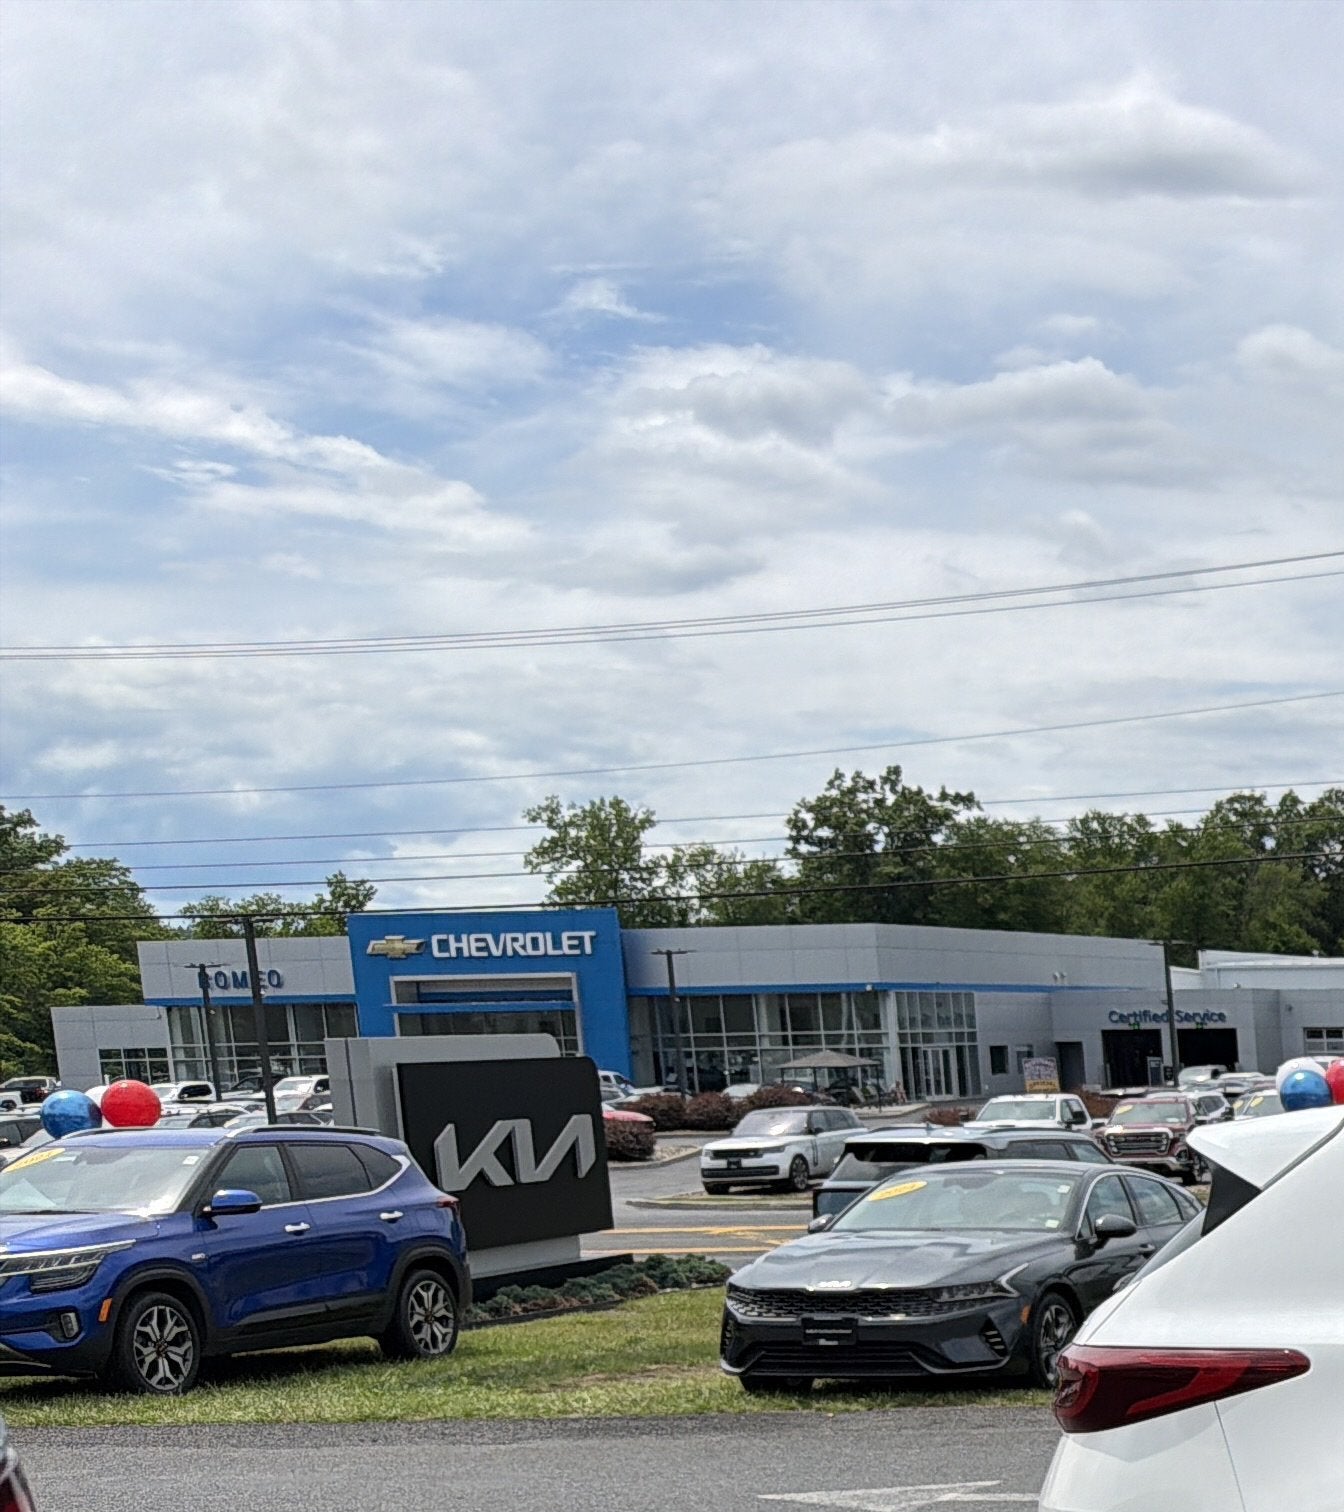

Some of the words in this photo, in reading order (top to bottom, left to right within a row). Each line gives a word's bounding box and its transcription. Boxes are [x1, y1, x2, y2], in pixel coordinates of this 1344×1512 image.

[431, 931, 596, 958] CHEVROLET
[1108, 1010, 1170, 1024] Certified
[1174, 1009, 1227, 1023] Service
